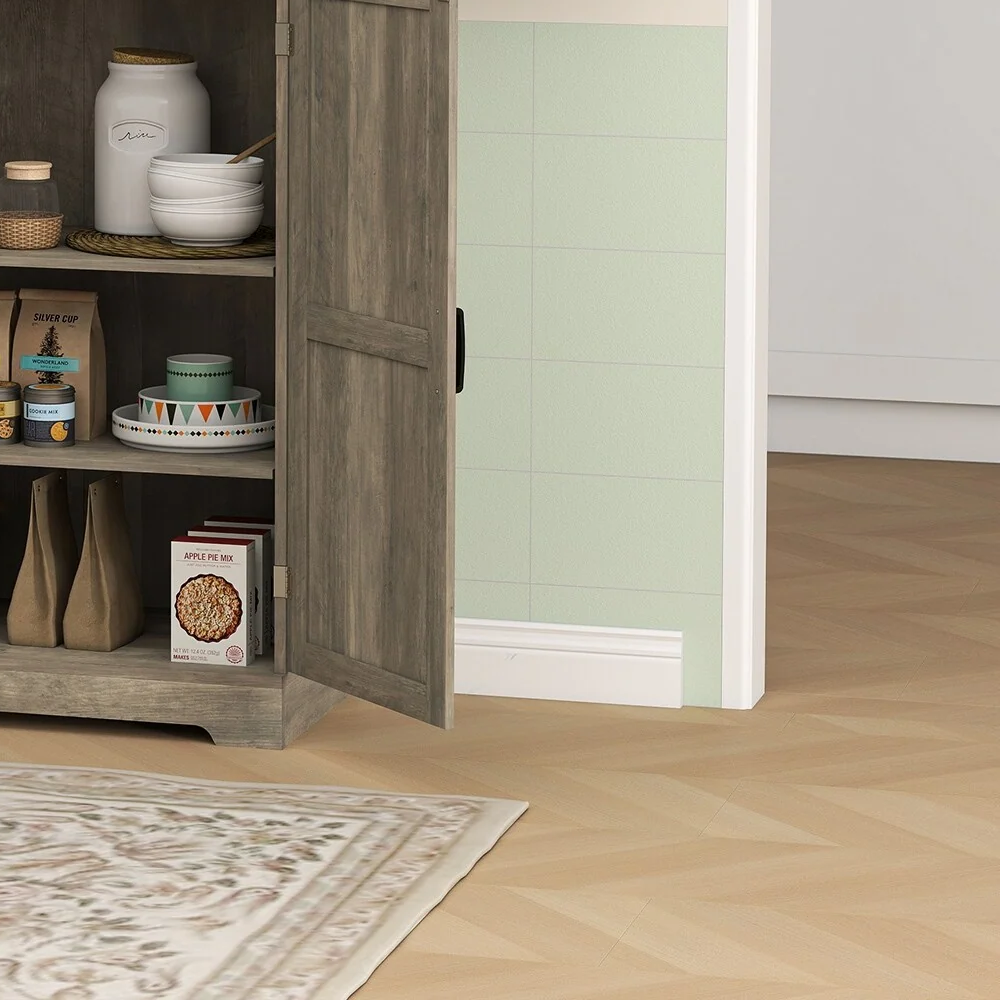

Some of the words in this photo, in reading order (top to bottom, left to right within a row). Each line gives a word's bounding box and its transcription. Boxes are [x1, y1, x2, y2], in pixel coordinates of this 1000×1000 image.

[34, 313, 60, 322] SILVER
[62, 315, 78, 323] CUP
[184, 552, 206, 560] APPLE
